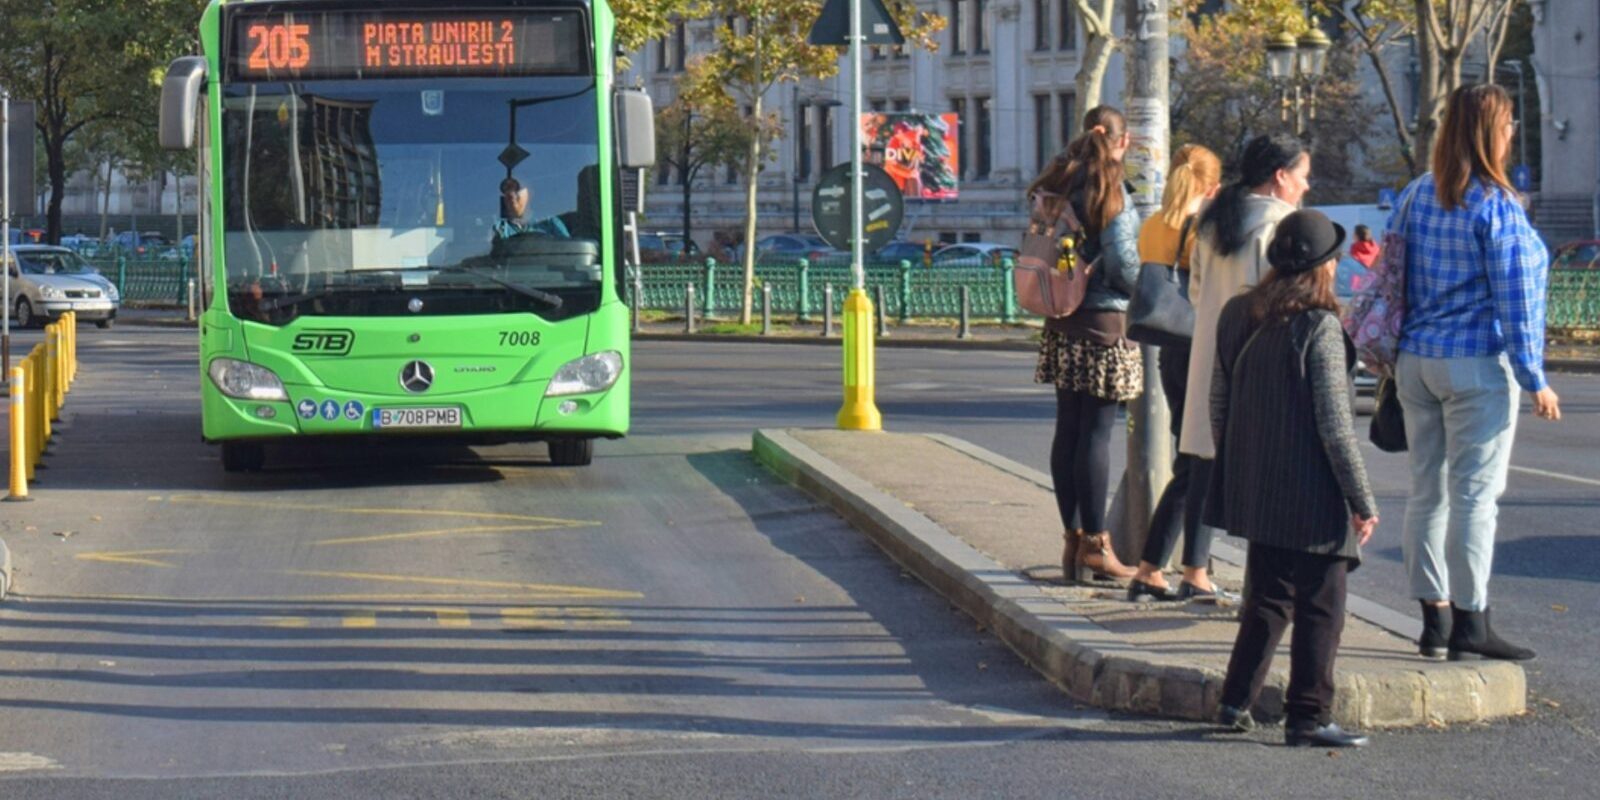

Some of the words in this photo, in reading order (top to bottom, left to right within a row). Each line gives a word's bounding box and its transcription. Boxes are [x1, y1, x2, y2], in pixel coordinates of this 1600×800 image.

[364, 23, 423, 44] PIATA
[431, 21, 493, 43] UNIRII
[501, 21, 514, 42] 2
[247, 24, 311, 69] 205
[366, 45, 381, 66] M
[292, 333, 349, 350] STB
[498, 331, 541, 346] 7008
